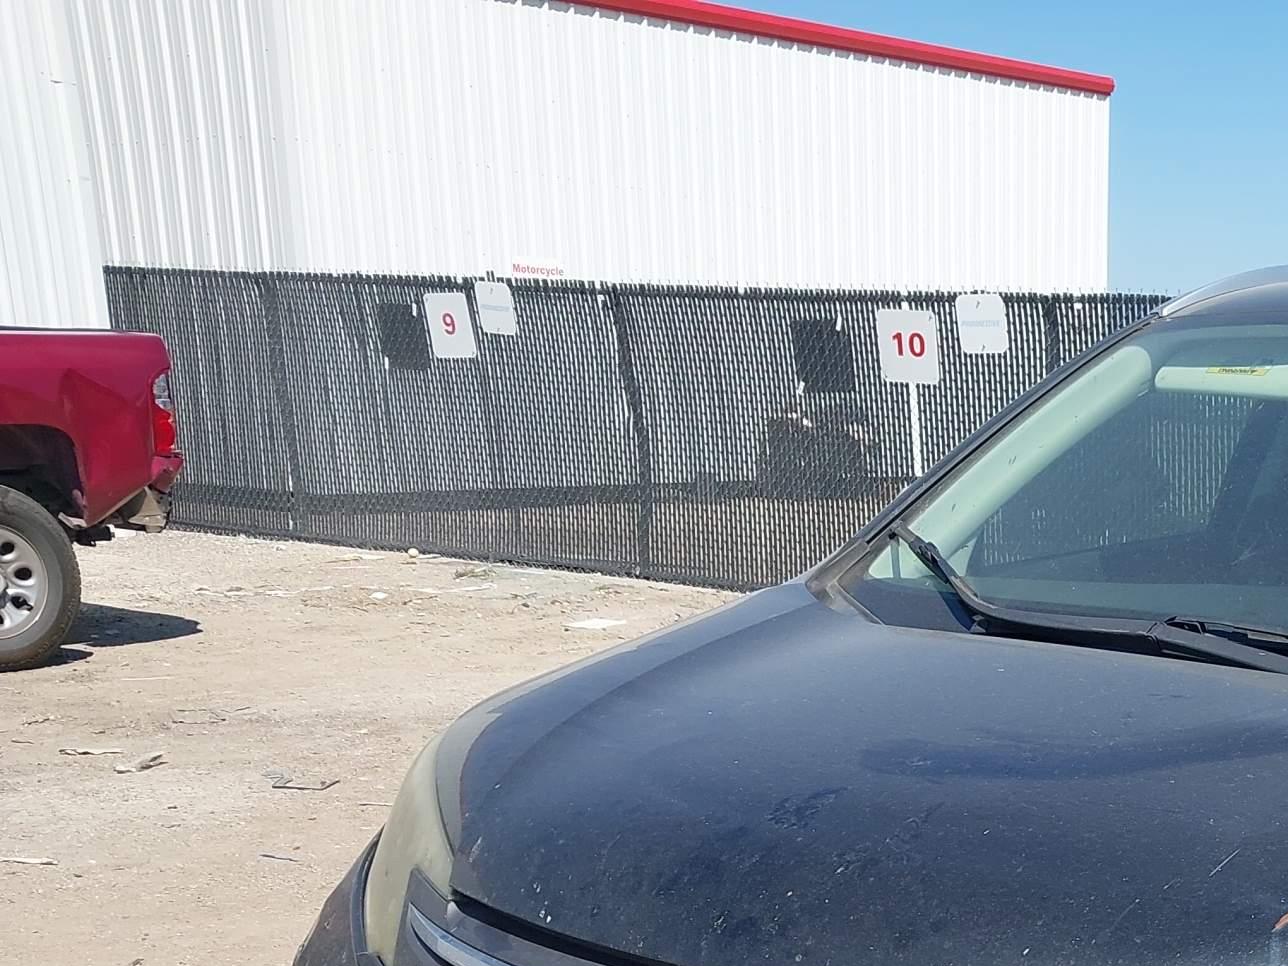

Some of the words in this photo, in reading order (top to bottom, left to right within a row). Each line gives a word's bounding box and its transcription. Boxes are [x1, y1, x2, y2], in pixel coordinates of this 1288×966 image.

[512, 263, 565, 277] Motorcycle
[441, 312, 457, 336] 9
[891, 331, 926, 358] 10
